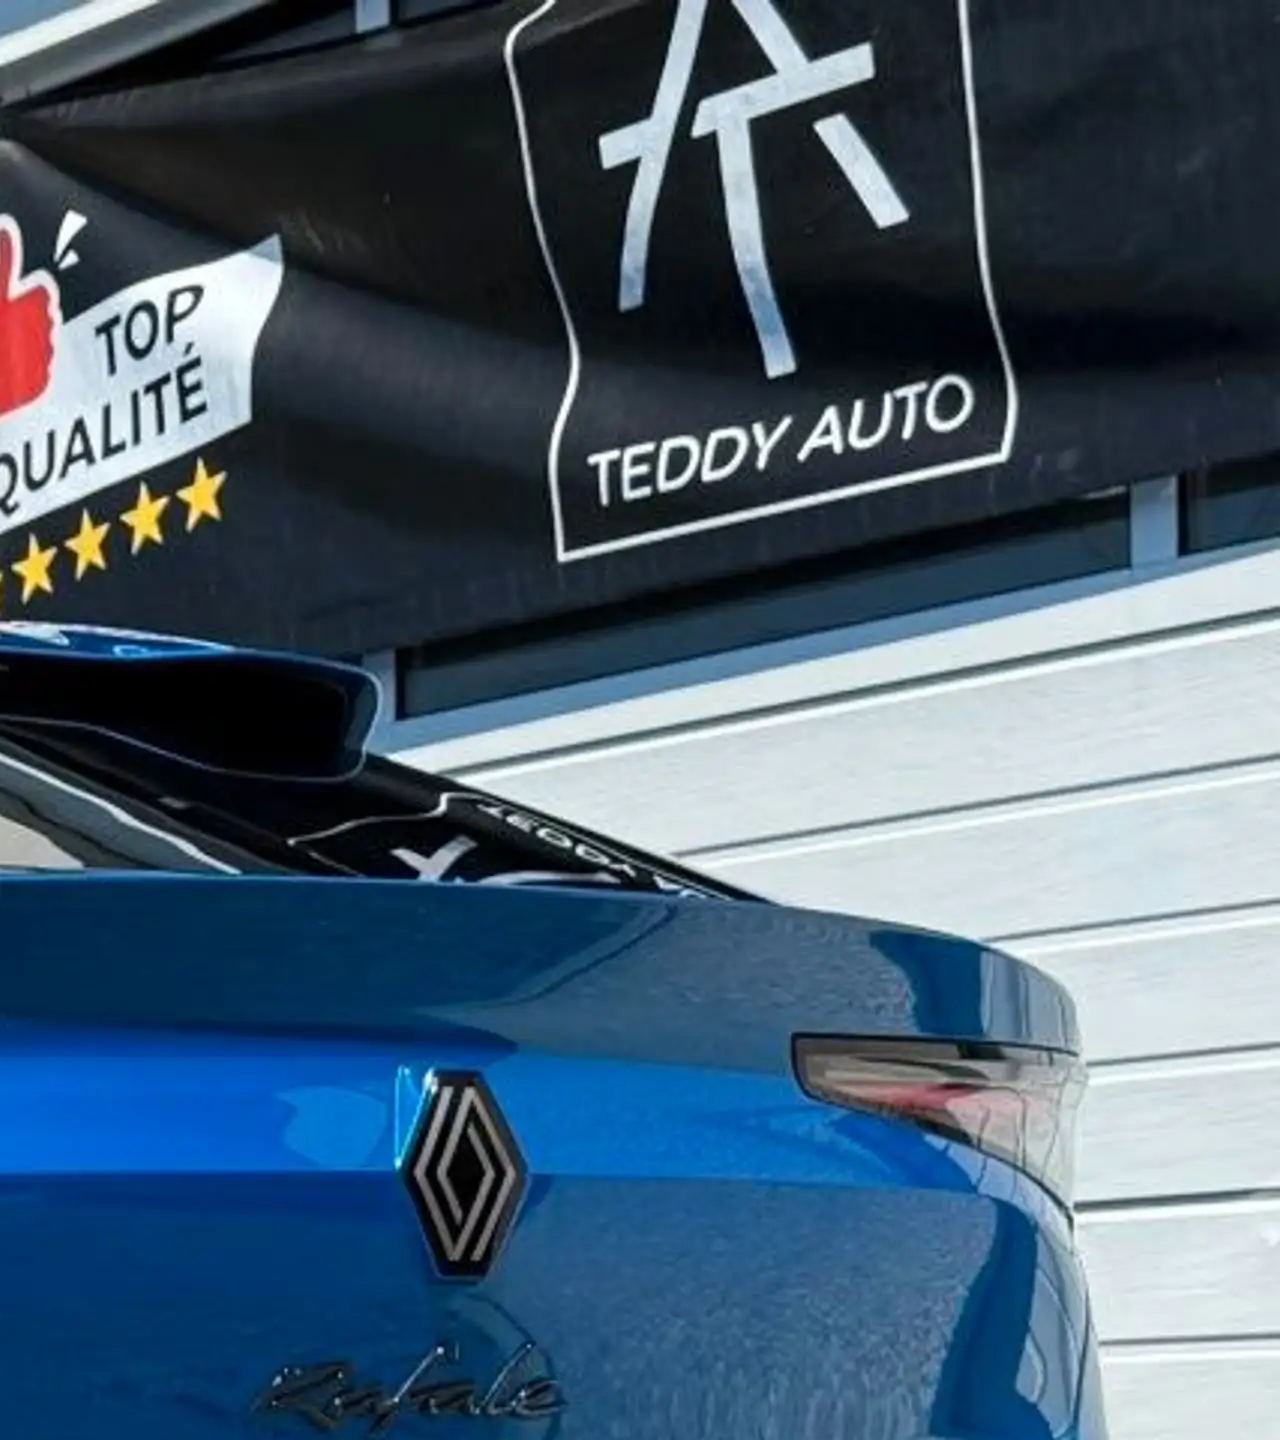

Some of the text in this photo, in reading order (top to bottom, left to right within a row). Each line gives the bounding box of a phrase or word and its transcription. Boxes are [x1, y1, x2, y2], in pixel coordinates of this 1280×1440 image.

[95, 285, 205, 377] TOP
[587, 373, 974, 506] TEDDY AUTO
